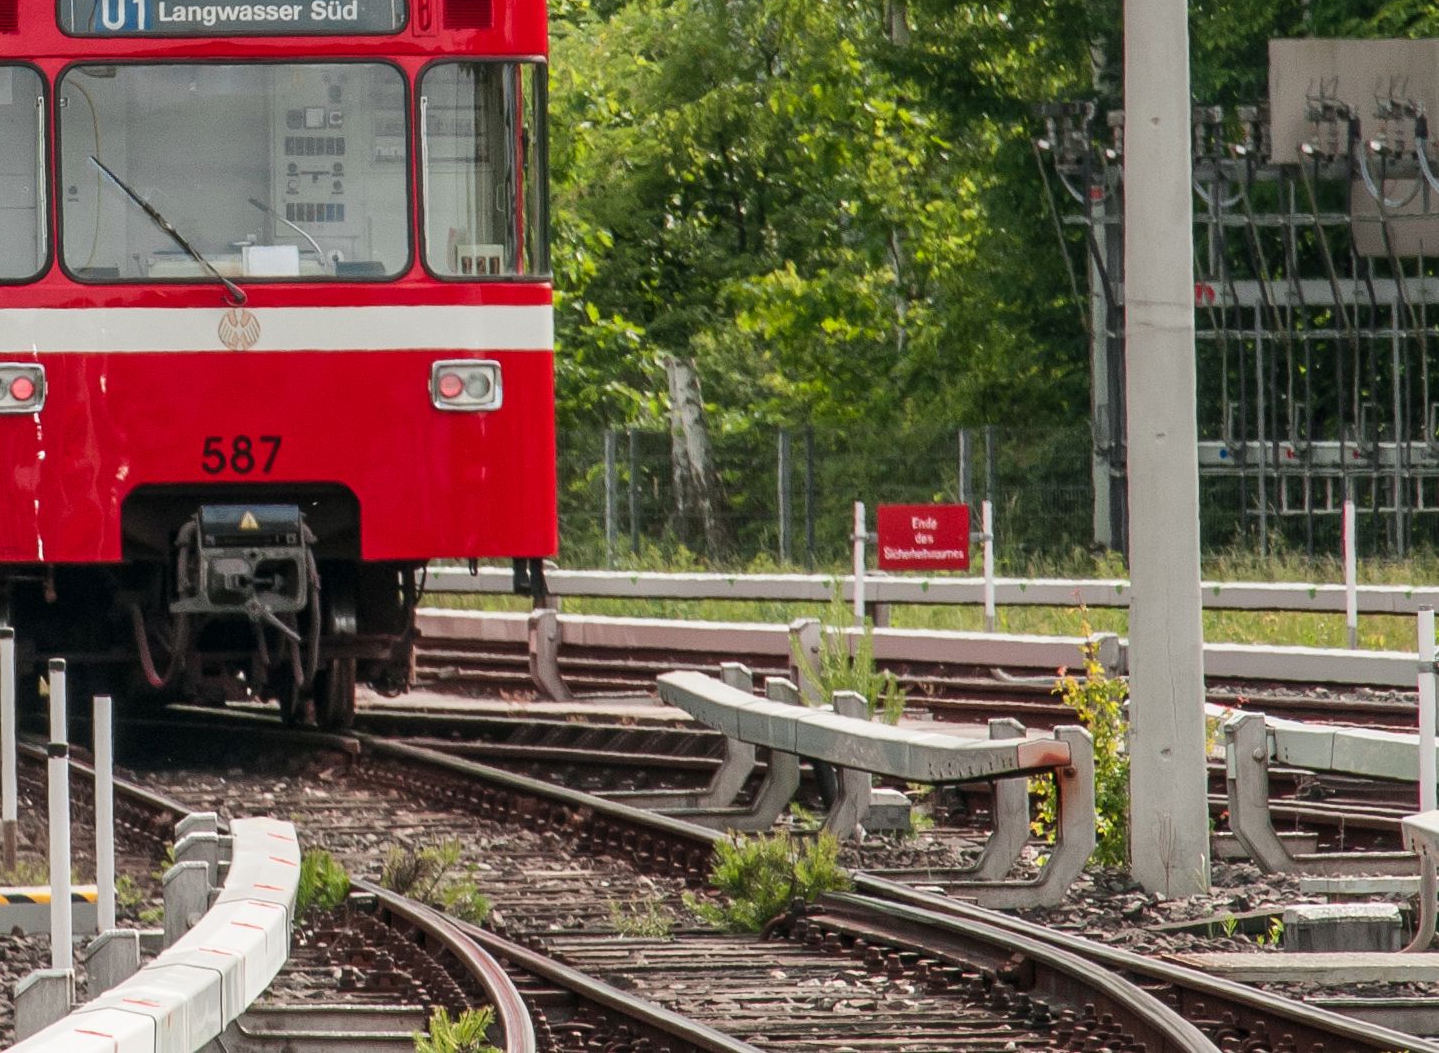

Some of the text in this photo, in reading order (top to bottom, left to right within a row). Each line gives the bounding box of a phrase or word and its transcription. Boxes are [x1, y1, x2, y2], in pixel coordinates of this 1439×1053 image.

[159, 0, 303, 26] Langwasser
[310, 0, 359, 21] Süd
[202, 435, 282, 475] 587
[911, 516, 938, 530] Ende
[914, 532, 934, 544] des
